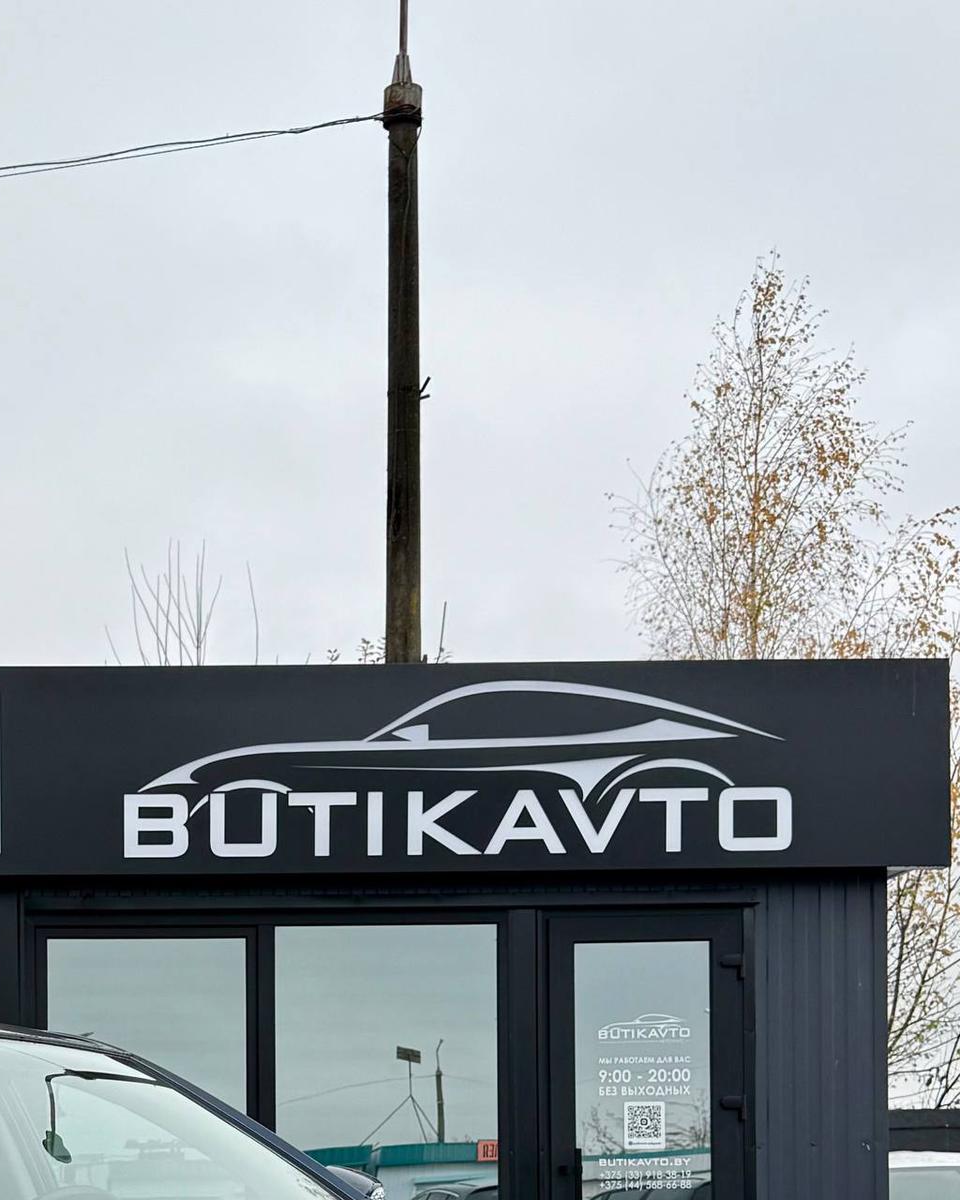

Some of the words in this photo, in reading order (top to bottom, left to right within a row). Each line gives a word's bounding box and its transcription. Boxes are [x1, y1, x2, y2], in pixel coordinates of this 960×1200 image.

[123, 786, 793, 858] BUTIKAVTO
[598, 1027, 690, 1039] BUTIKAVTO
[614, 1056, 655, 1064] РАБОТАЕМ
[656, 1056, 672, 1064] ДЛЯ
[599, 1069, 631, 1083] 9:00
[648, 1068, 691, 1082] 20:00
[599, 1086, 617, 1096] БЕЗ
[621, 1085, 691, 1096] ВЫХОДНЫХ
[599, 1158, 691, 1167] BUTIKAVTO.BY
[600, 1170, 622, 1179] +375
[625, 1170, 643, 1181] (33)
[600, 1180, 622, 1190] +375
[625, 1180, 643, 1191] (44)
